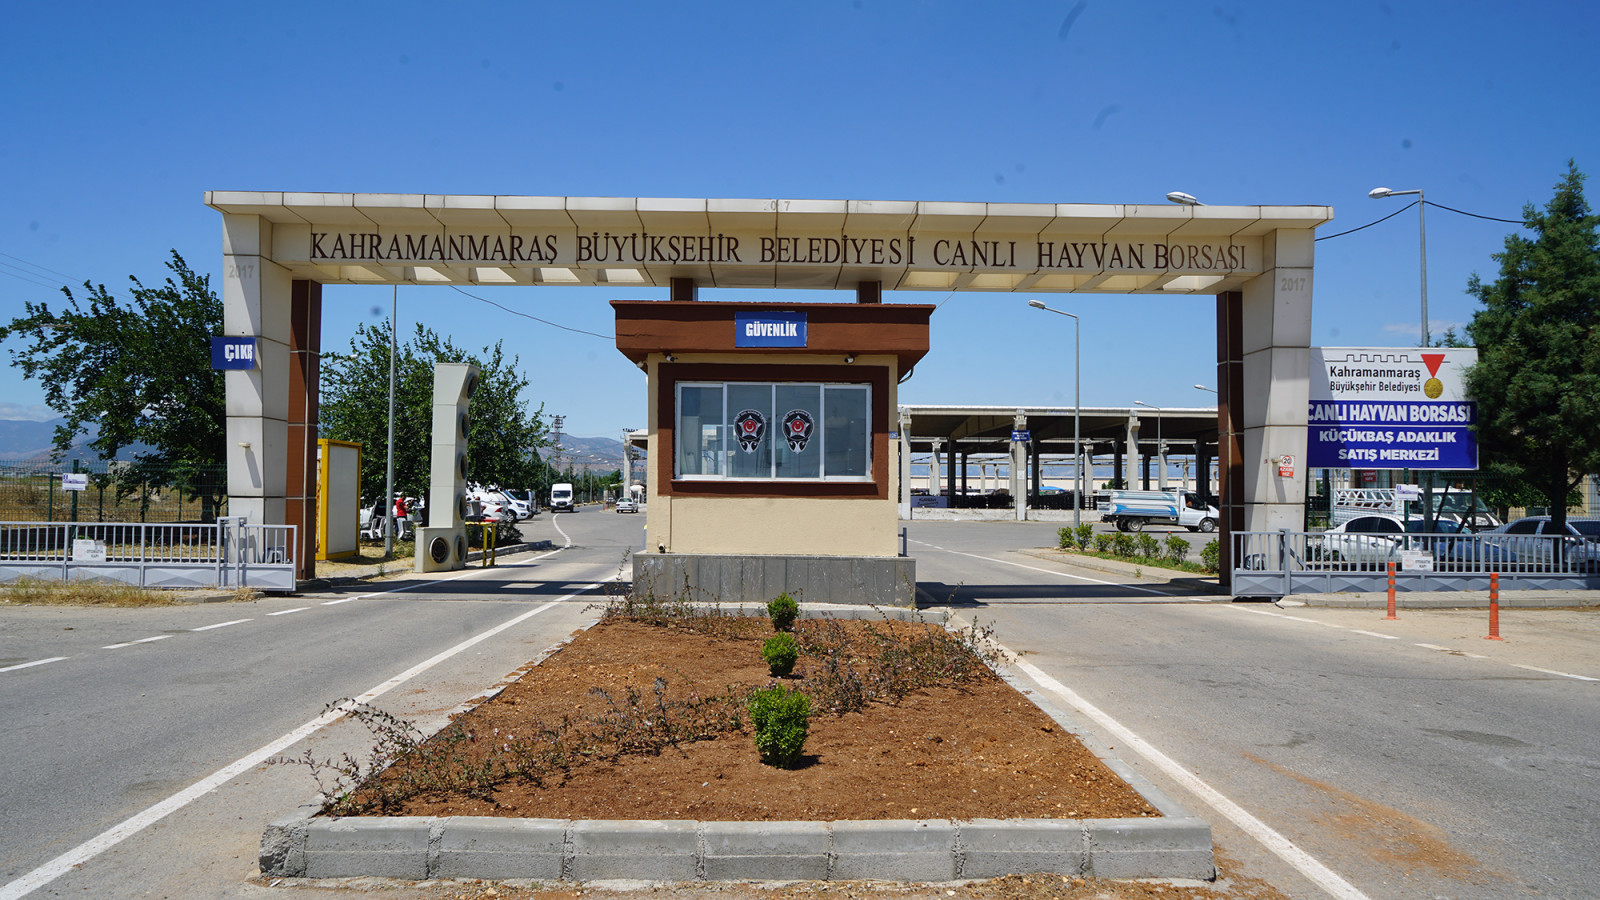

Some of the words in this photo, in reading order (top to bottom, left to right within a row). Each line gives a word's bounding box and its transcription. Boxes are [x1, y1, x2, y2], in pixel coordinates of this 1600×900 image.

[311, 232, 558, 264] KAHRAMANMARAŞ
[576, 232, 742, 265] BÜYÜKŞEHİR
[759, 234, 915, 265] BELEDİYESİ
[933, 239, 1017, 267] CANLI
[1037, 242, 1145, 269] HAYVAN
[1153, 243, 1248, 270] BORSASI
[228, 265, 254, 279] 2017
[1281, 278, 1306, 291] 2017
[745, 321, 798, 337] GÜVENLİK
[1330, 366, 1421, 381] Kahramanmaraş
[1330, 381, 1377, 394] Büyükşehir
[1379, 382, 1421, 394] Belediyesi
[1349, 404, 1407, 422] HAYVAN
[1409, 405, 1471, 422] BORSASI
[1319, 429, 1394, 444] KÜÇÜKBAŞ
[1396, 431, 1457, 443] ADAKLIK
[1338, 448, 1378, 461] SATIŞ
[1379, 447, 1440, 461] MERKEZİ
